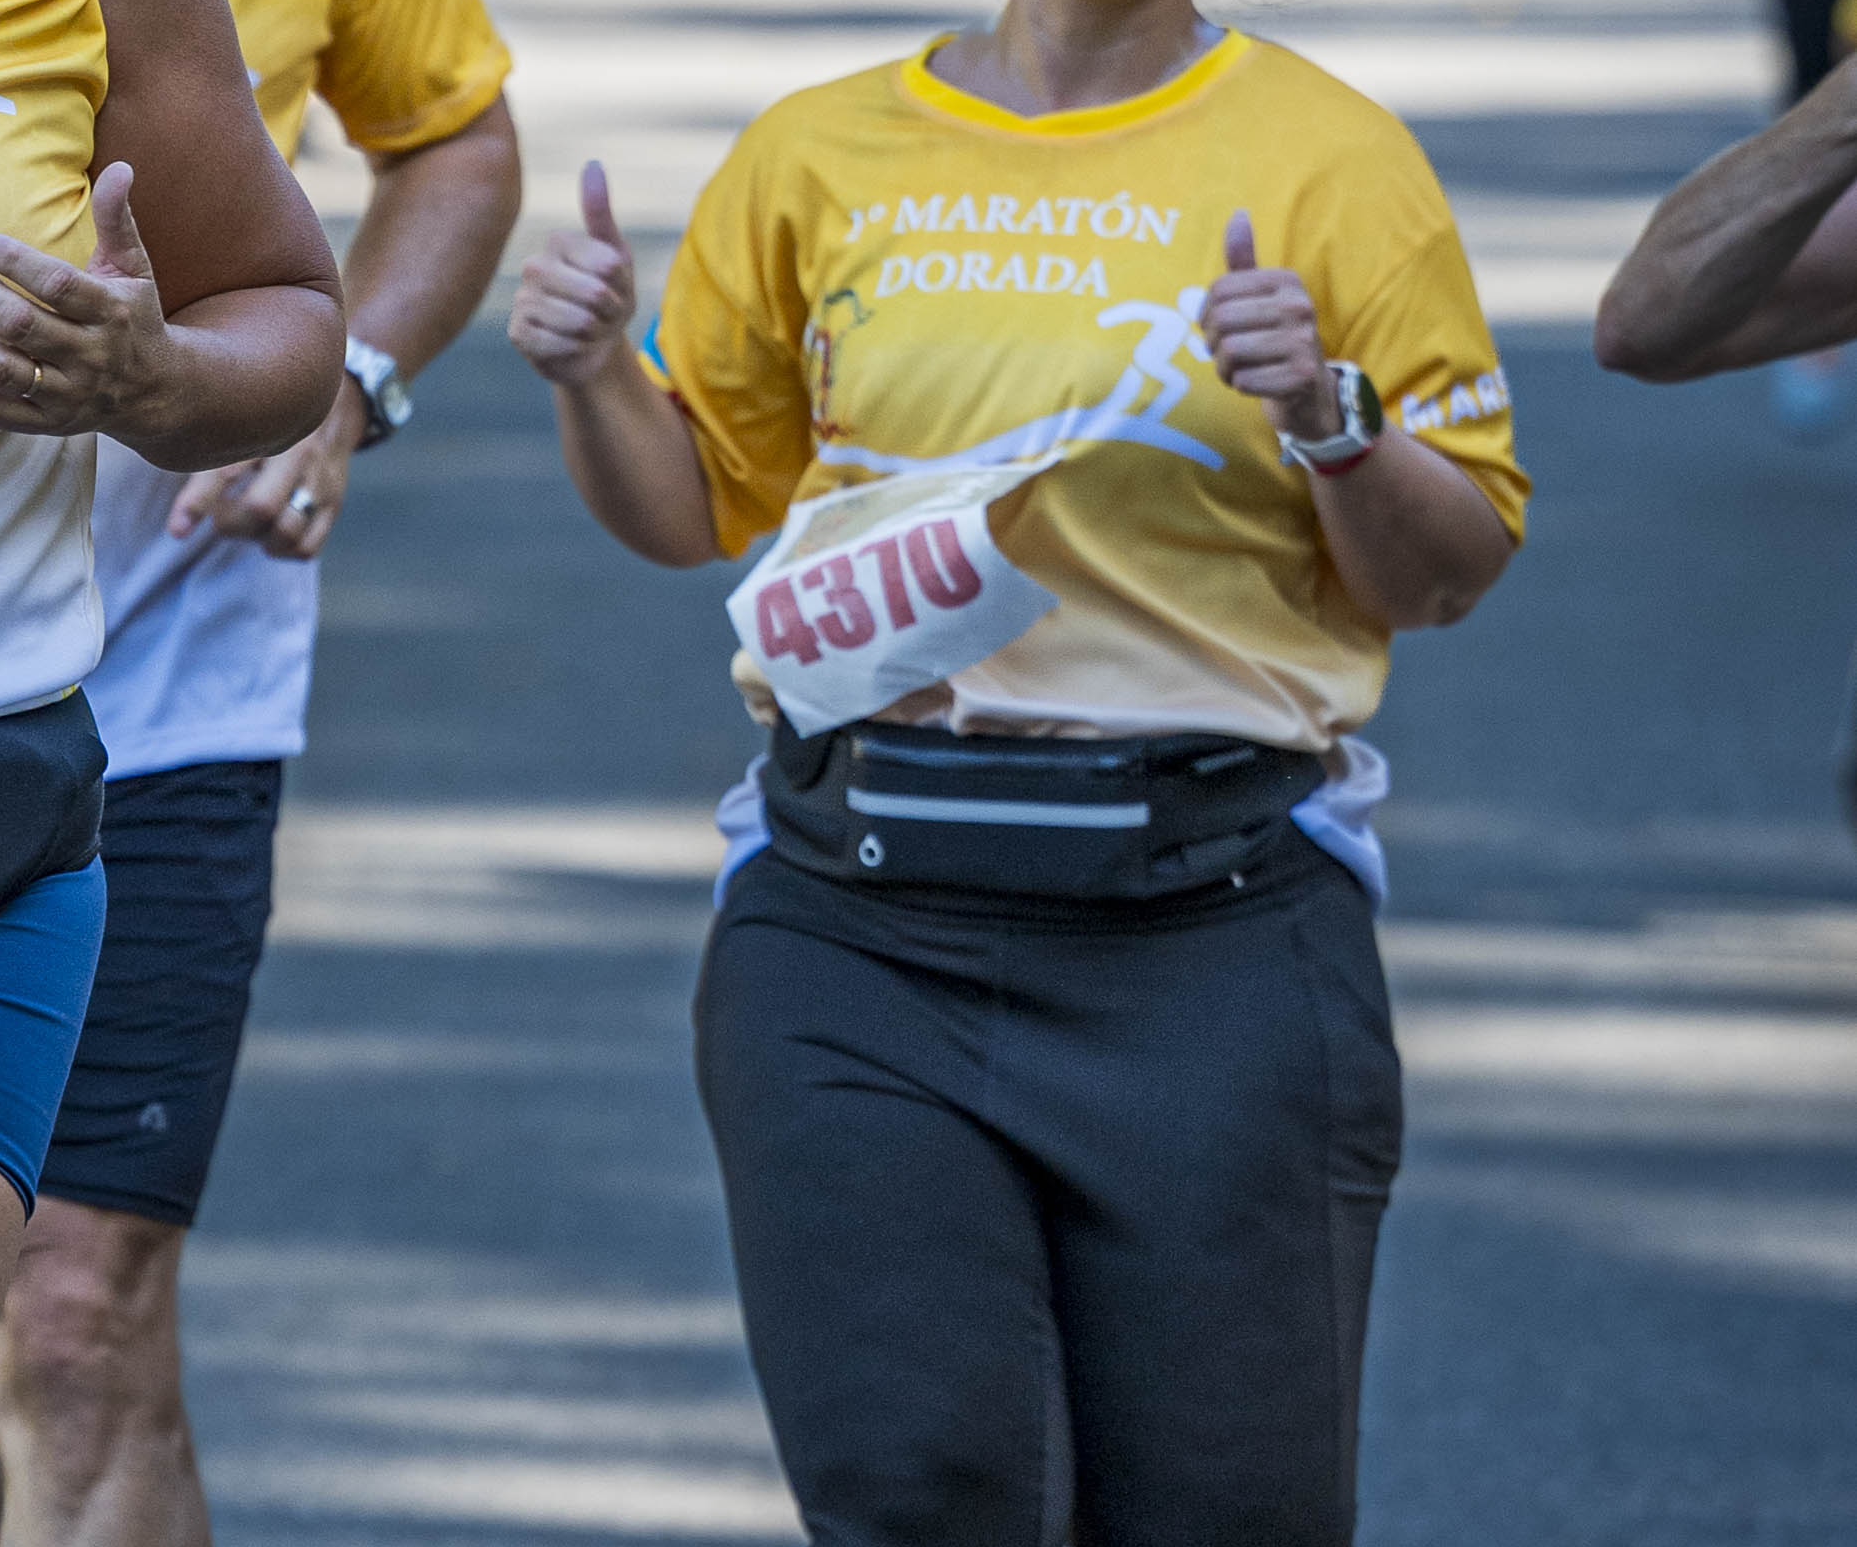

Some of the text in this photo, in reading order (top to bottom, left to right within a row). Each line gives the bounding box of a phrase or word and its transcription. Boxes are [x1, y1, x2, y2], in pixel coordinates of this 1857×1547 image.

[892, 191, 1180, 246] MARATÓN
[874, 251, 1110, 299] DORADA
[755, 518, 983, 666] 4370
